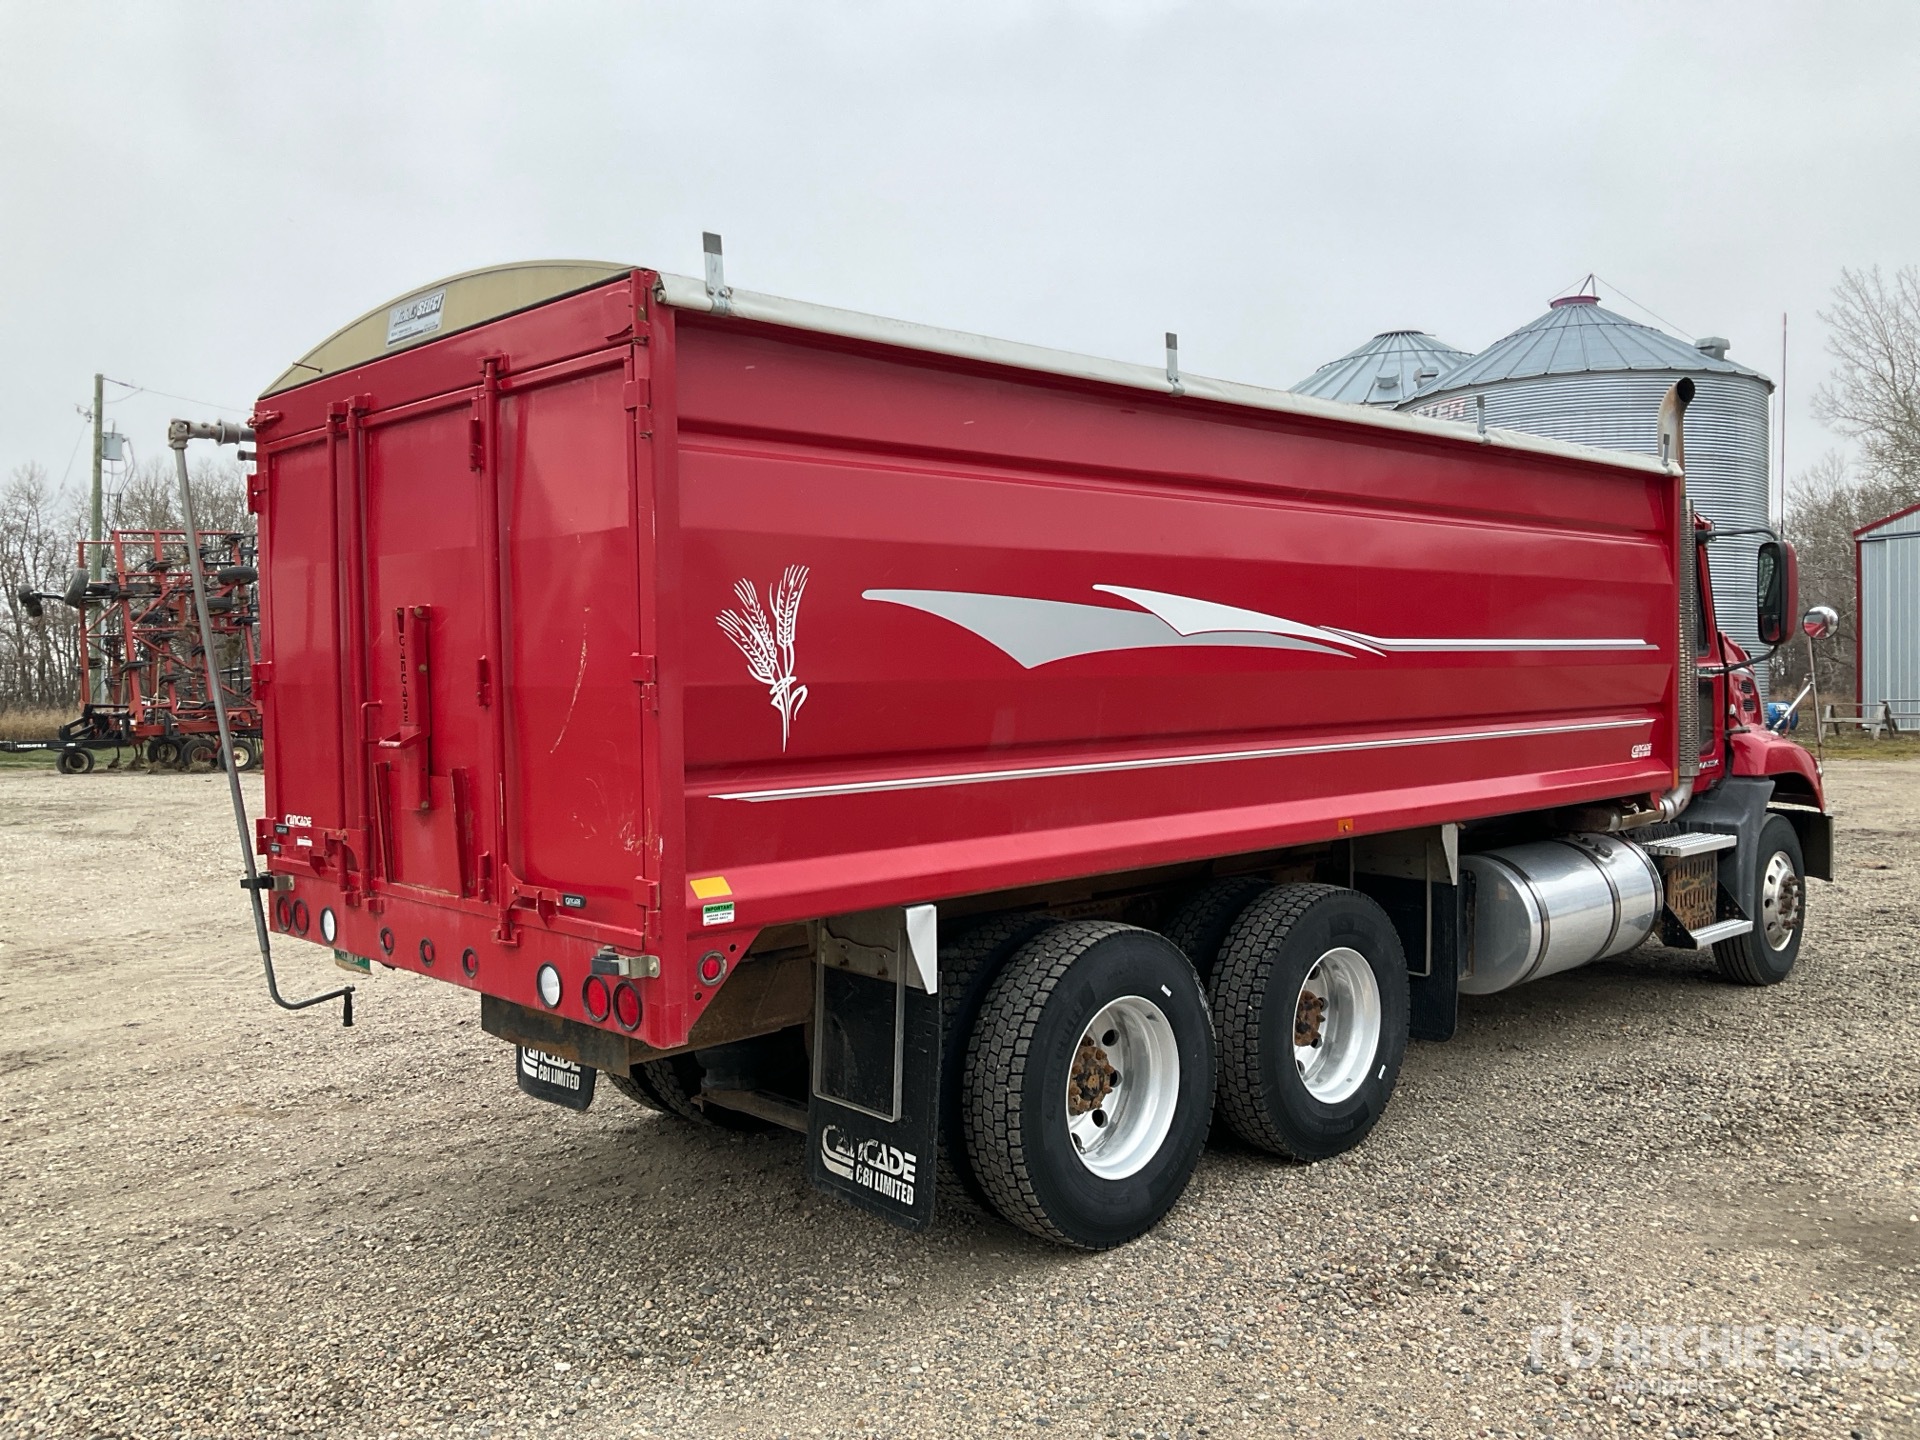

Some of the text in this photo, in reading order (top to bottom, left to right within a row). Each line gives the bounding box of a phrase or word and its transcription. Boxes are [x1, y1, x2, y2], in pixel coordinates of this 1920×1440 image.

[416, 293, 444, 319] SELECT
[705, 903, 733, 912] IMPORTANT
[538, 1063, 580, 1091] CBI LIMITED
[855, 1163, 914, 1206] CBI LIMITED
